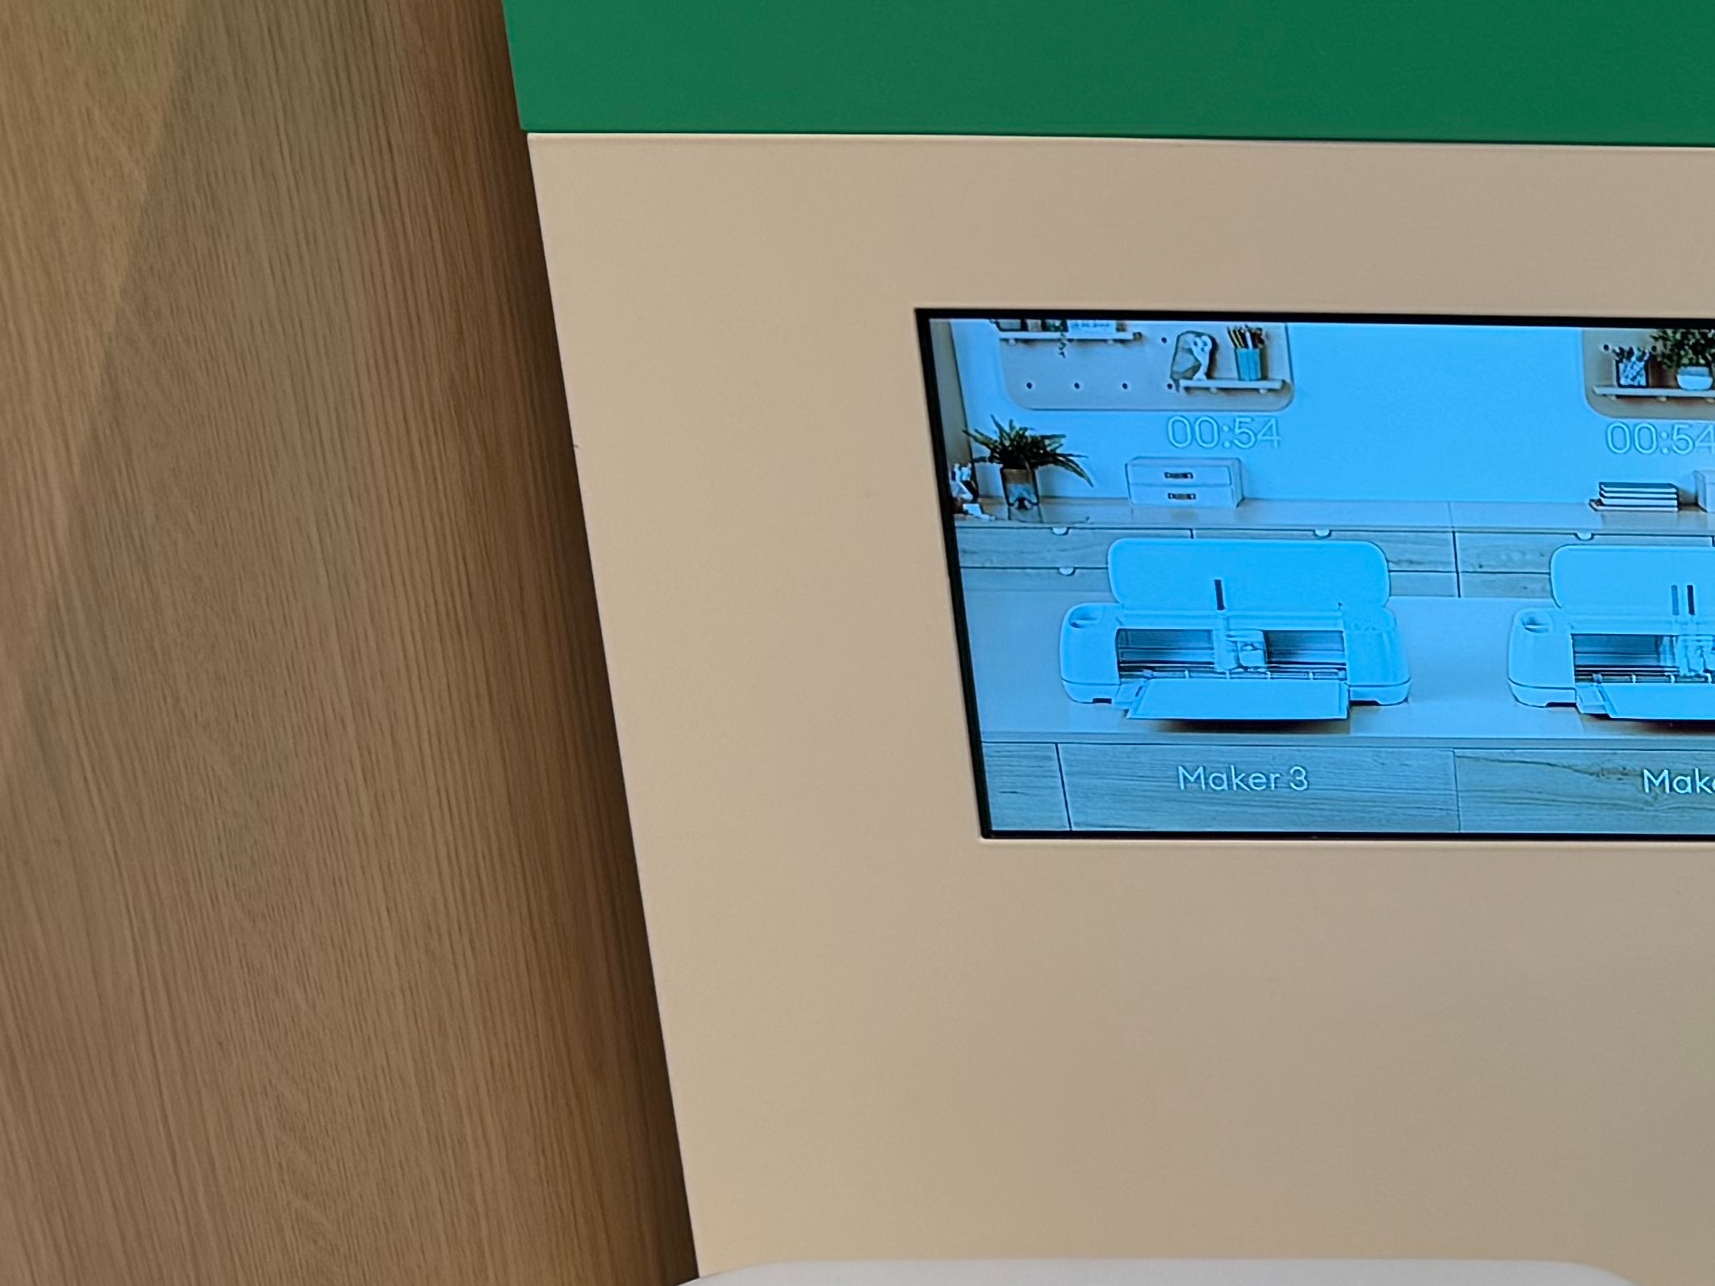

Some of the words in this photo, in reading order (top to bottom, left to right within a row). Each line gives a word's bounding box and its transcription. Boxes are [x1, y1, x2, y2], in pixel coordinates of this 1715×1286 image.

[1167, 415, 1282, 450] 00:54
[1177, 764, 1282, 792] Maker
[1289, 765, 1309, 792] 3
